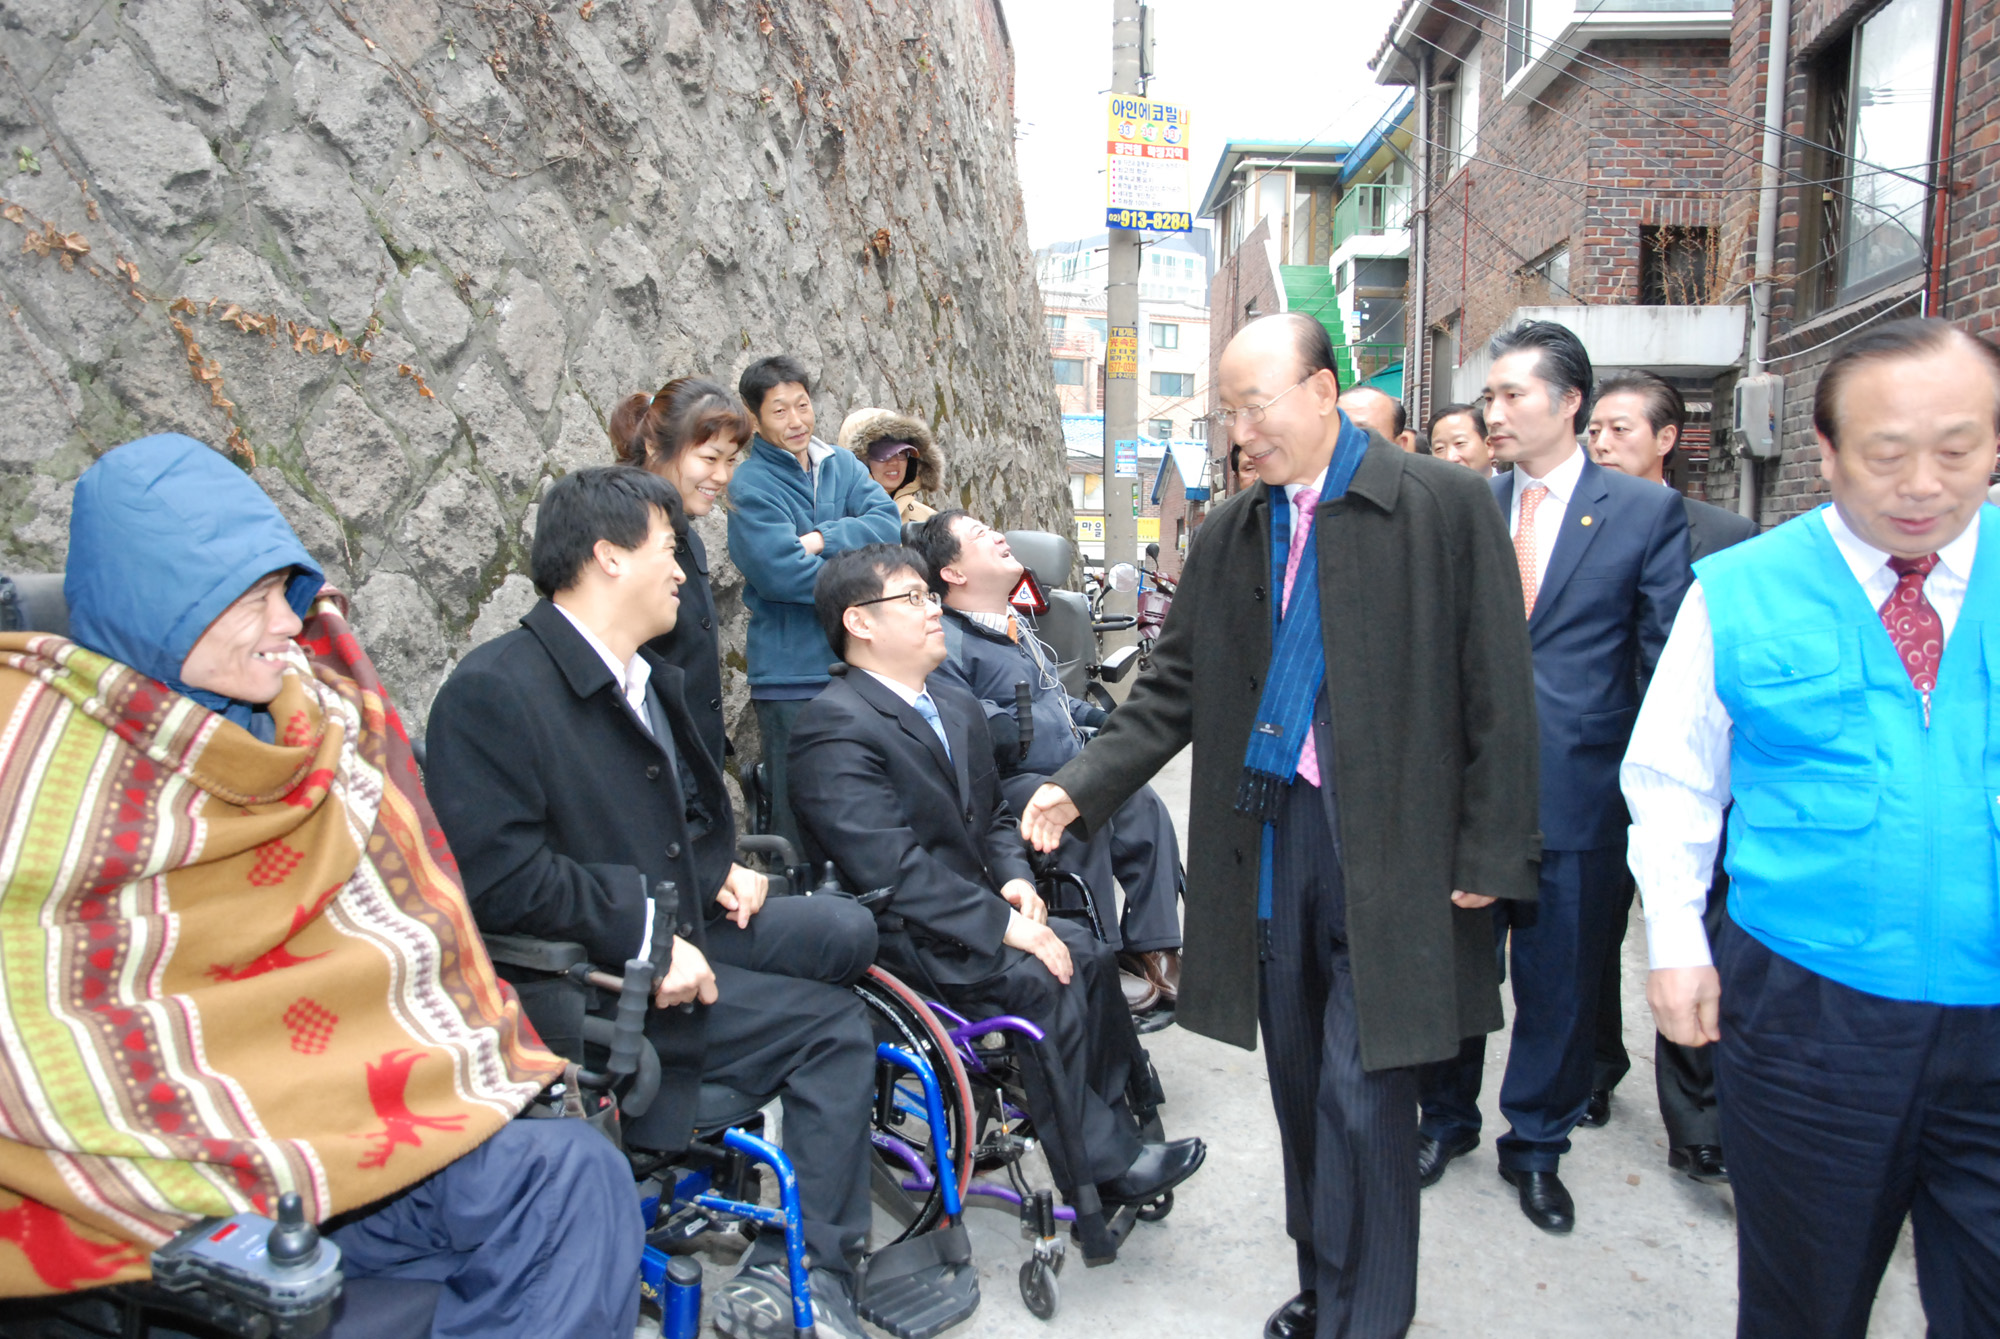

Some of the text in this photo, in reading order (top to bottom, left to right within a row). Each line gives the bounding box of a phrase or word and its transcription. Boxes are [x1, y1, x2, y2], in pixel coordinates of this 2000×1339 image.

[1112, 99, 1177, 123] 아인에코빌
[1119, 124, 1131, 135] 33
[1142, 127, 1152, 137] 34
